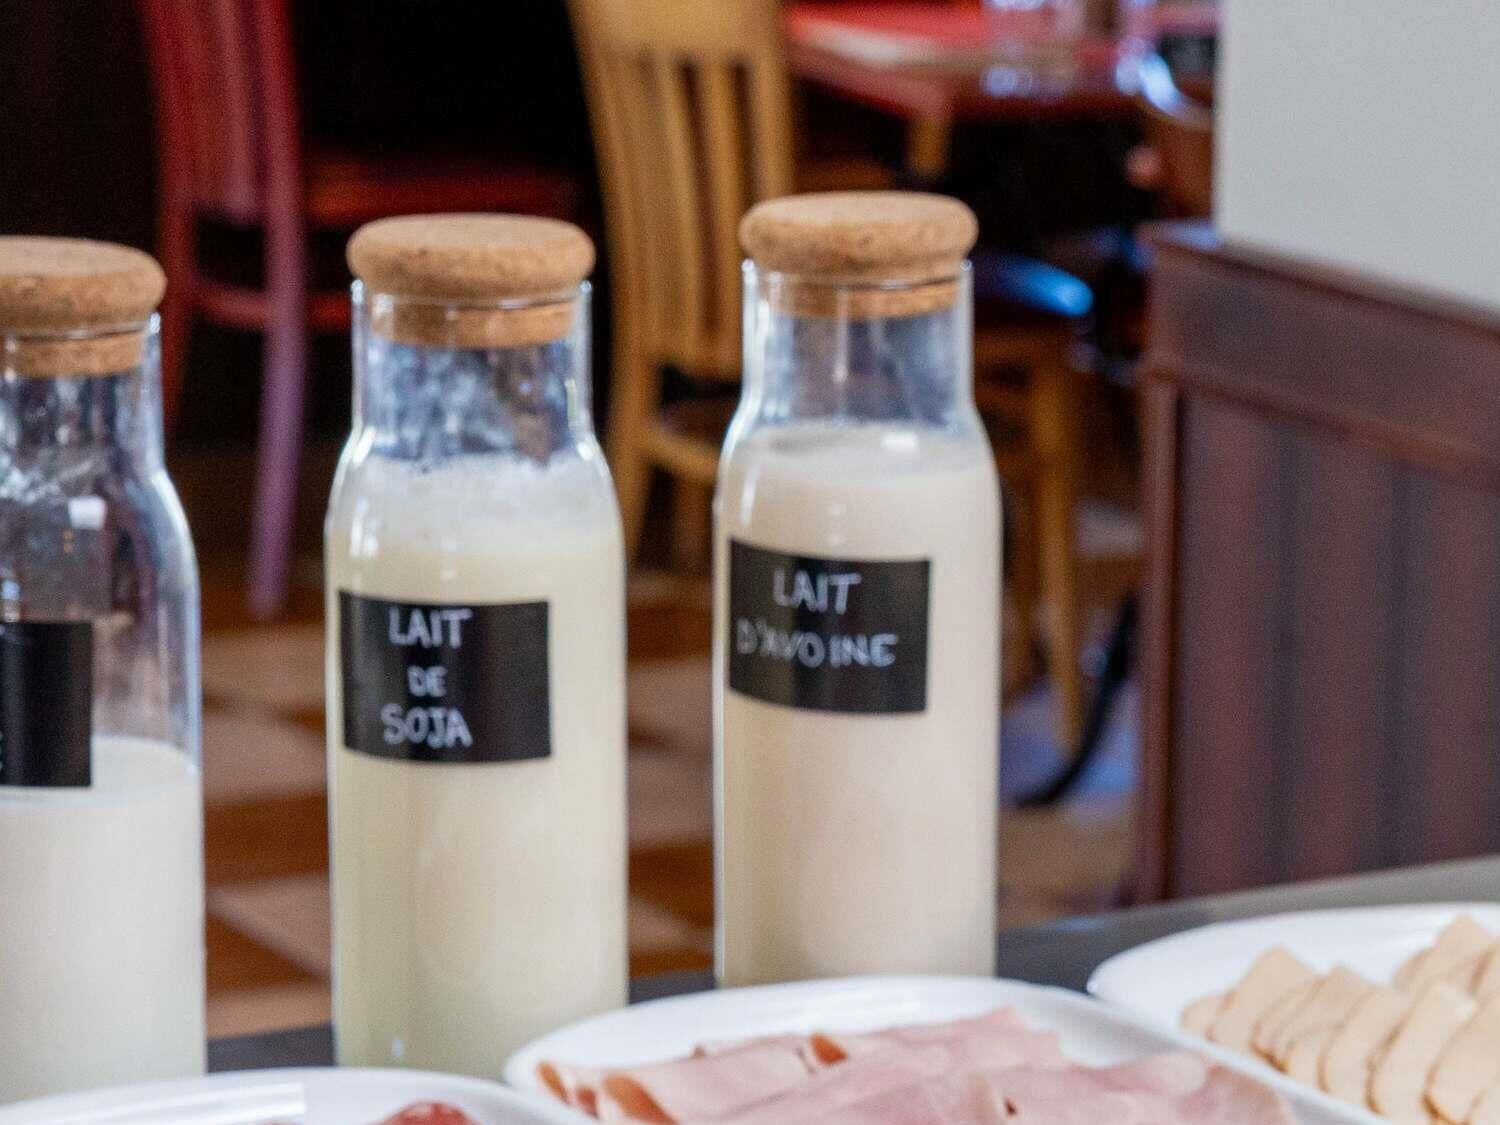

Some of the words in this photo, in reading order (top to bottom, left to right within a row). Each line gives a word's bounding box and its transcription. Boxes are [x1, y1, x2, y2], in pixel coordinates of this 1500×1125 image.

[773, 568, 863, 615] LAIT
[388, 606, 474, 649] LAIT
[736, 616, 899, 668] D'AVOINE
[406, 665, 448, 698] DE
[380, 702, 474, 749] SOJA
